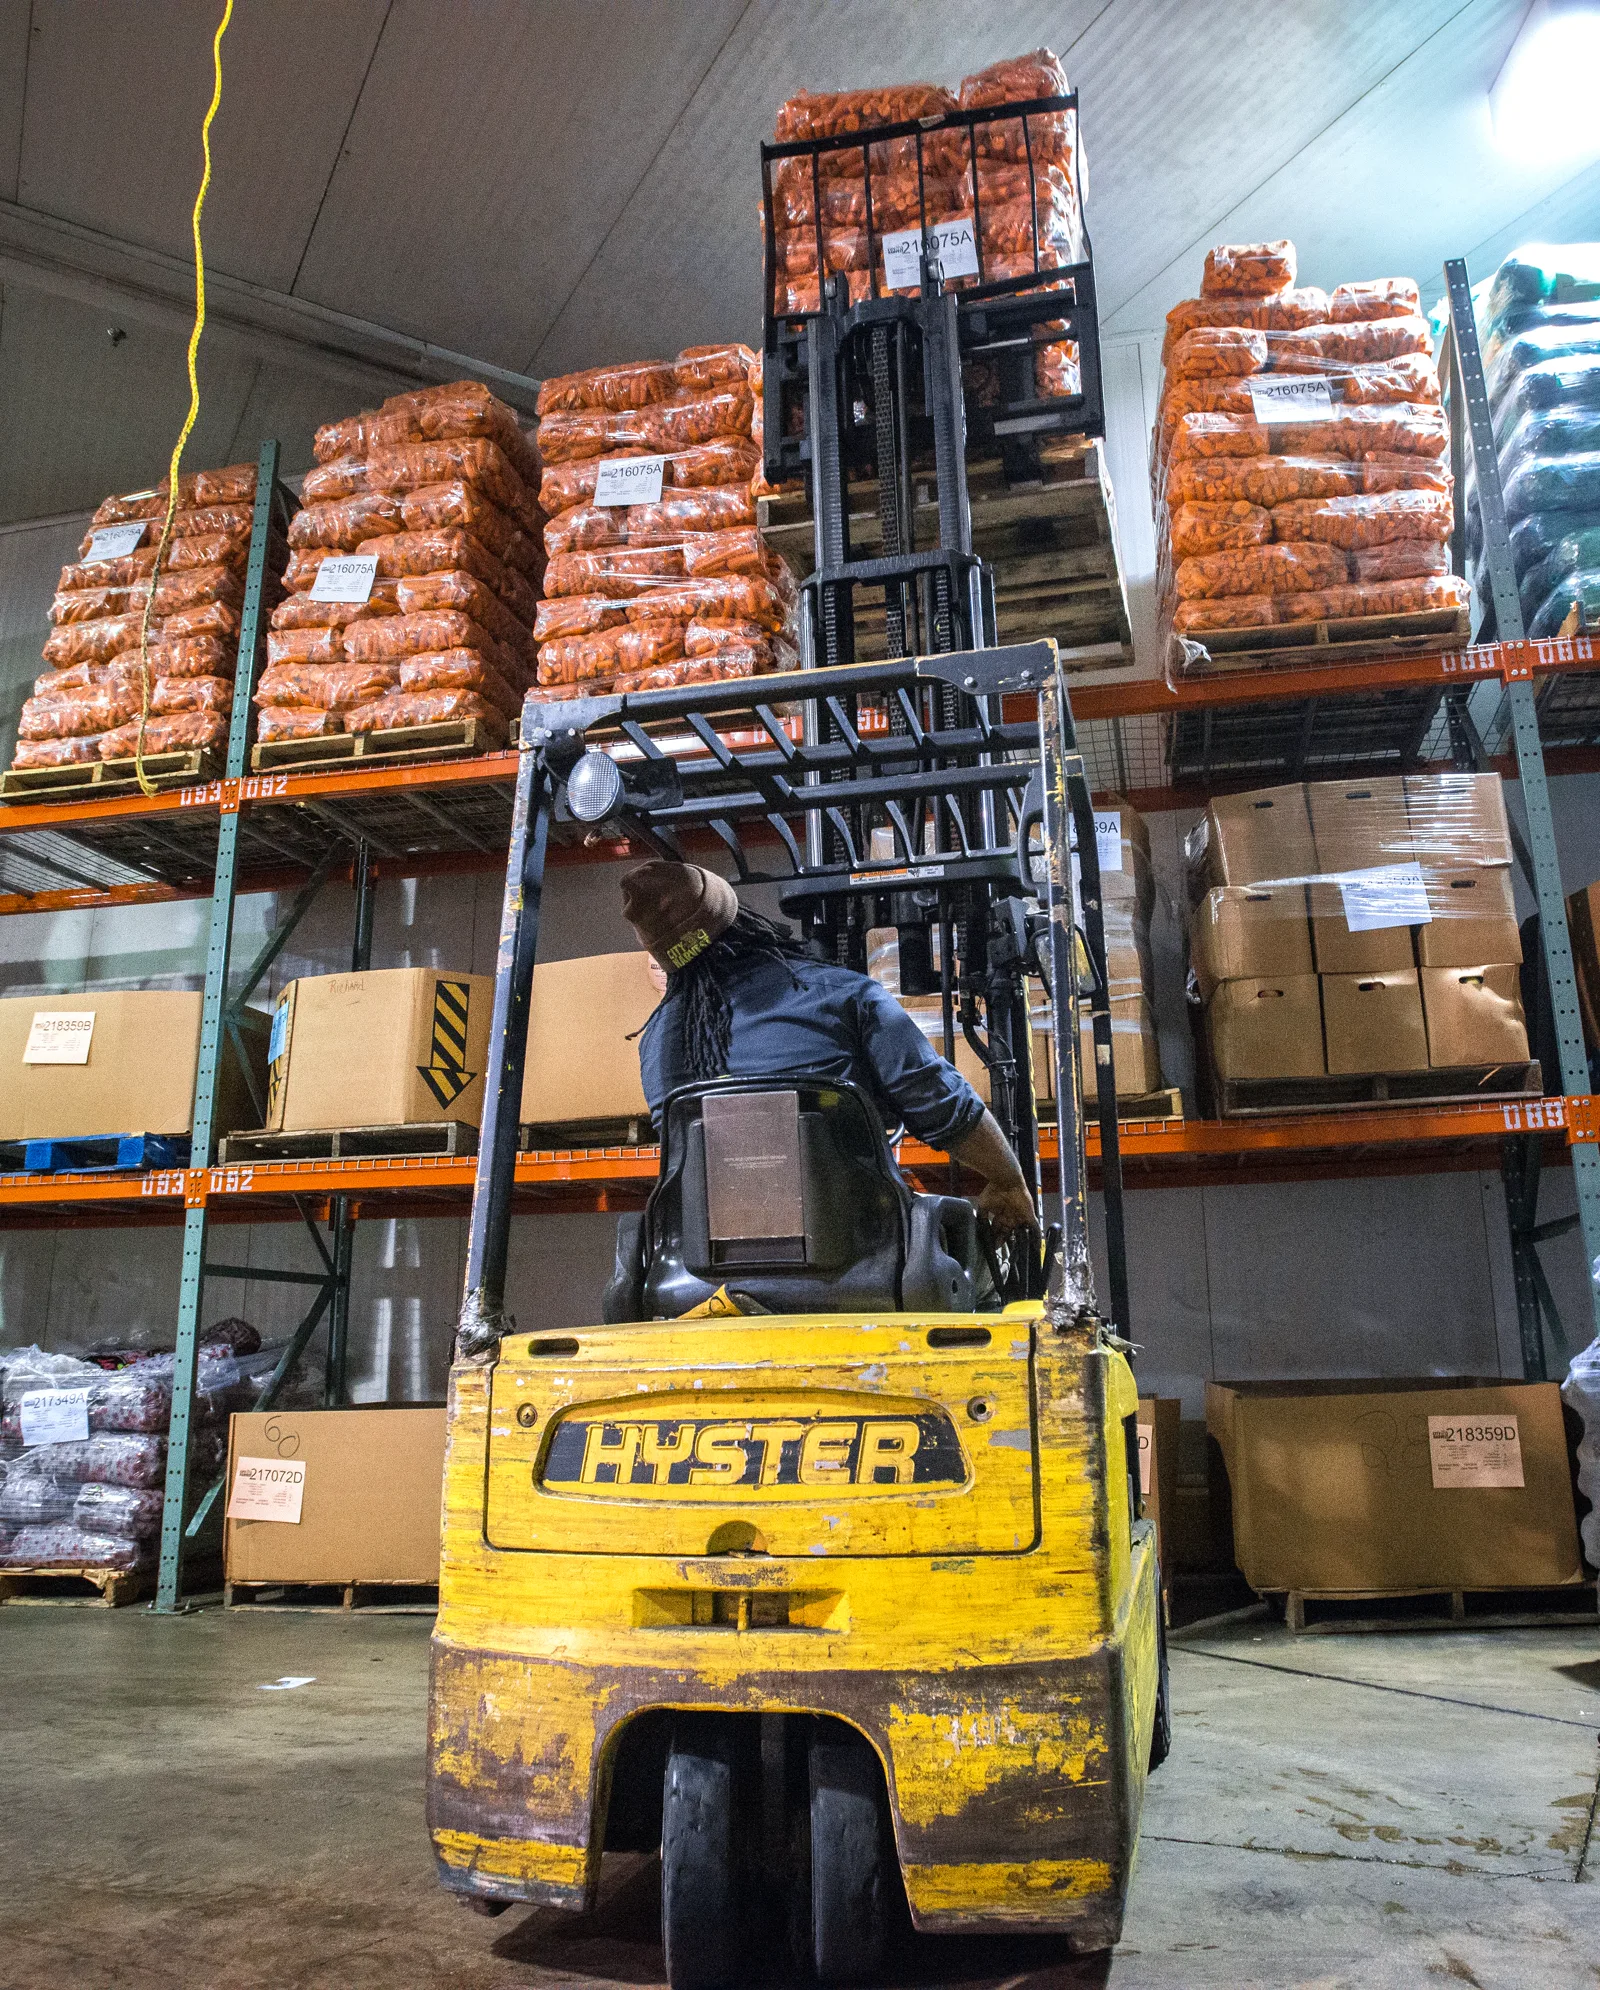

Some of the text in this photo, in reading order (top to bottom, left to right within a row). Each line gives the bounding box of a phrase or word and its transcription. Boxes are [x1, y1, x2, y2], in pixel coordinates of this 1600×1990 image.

[1267, 382, 1326, 397] 216075A
[611, 464, 662, 478] 216075A
[329, 563, 374, 574] 216075A
[1442, 648, 1495, 672] 089
[181, 781, 222, 806] 093
[247, 775, 287, 798] 092
[667, 941, 686, 960] CITY
[43, 1020, 92, 1031] 218359B
[1503, 1101, 1564, 1130] 089
[142, 1173, 184, 1195] 093
[210, 1169, 253, 1192] 092
[34, 1392, 85, 1409] 217349A
[1446, 1426, 1516, 1442] 218359D
[581, 1420, 920, 1485] HYSTER
[249, 1468, 303, 1484] 217072D
